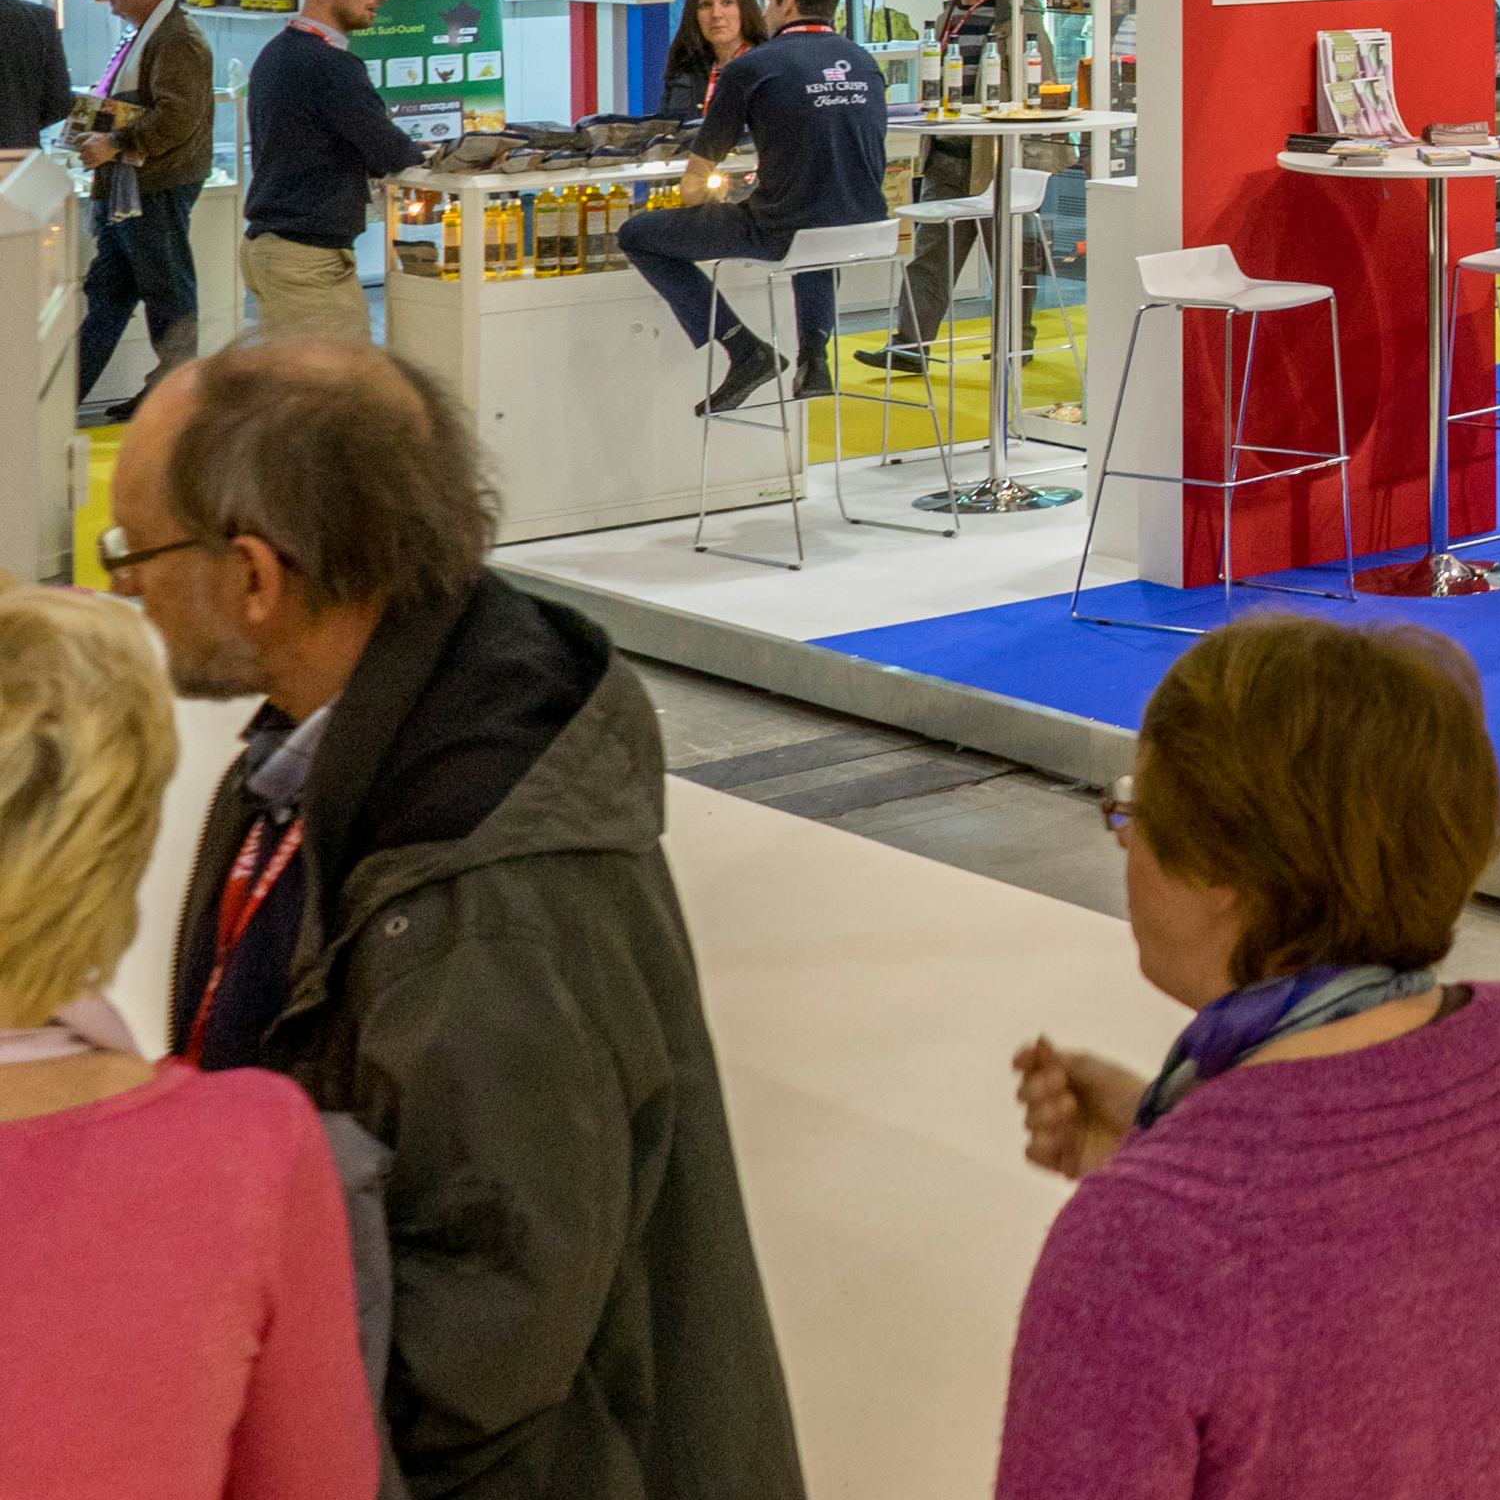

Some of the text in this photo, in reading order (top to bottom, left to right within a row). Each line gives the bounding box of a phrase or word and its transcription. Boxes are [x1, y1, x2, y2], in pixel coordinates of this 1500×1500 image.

[805, 81, 869, 94] KENT CRISPS
[419, 101, 461, 112] marques
